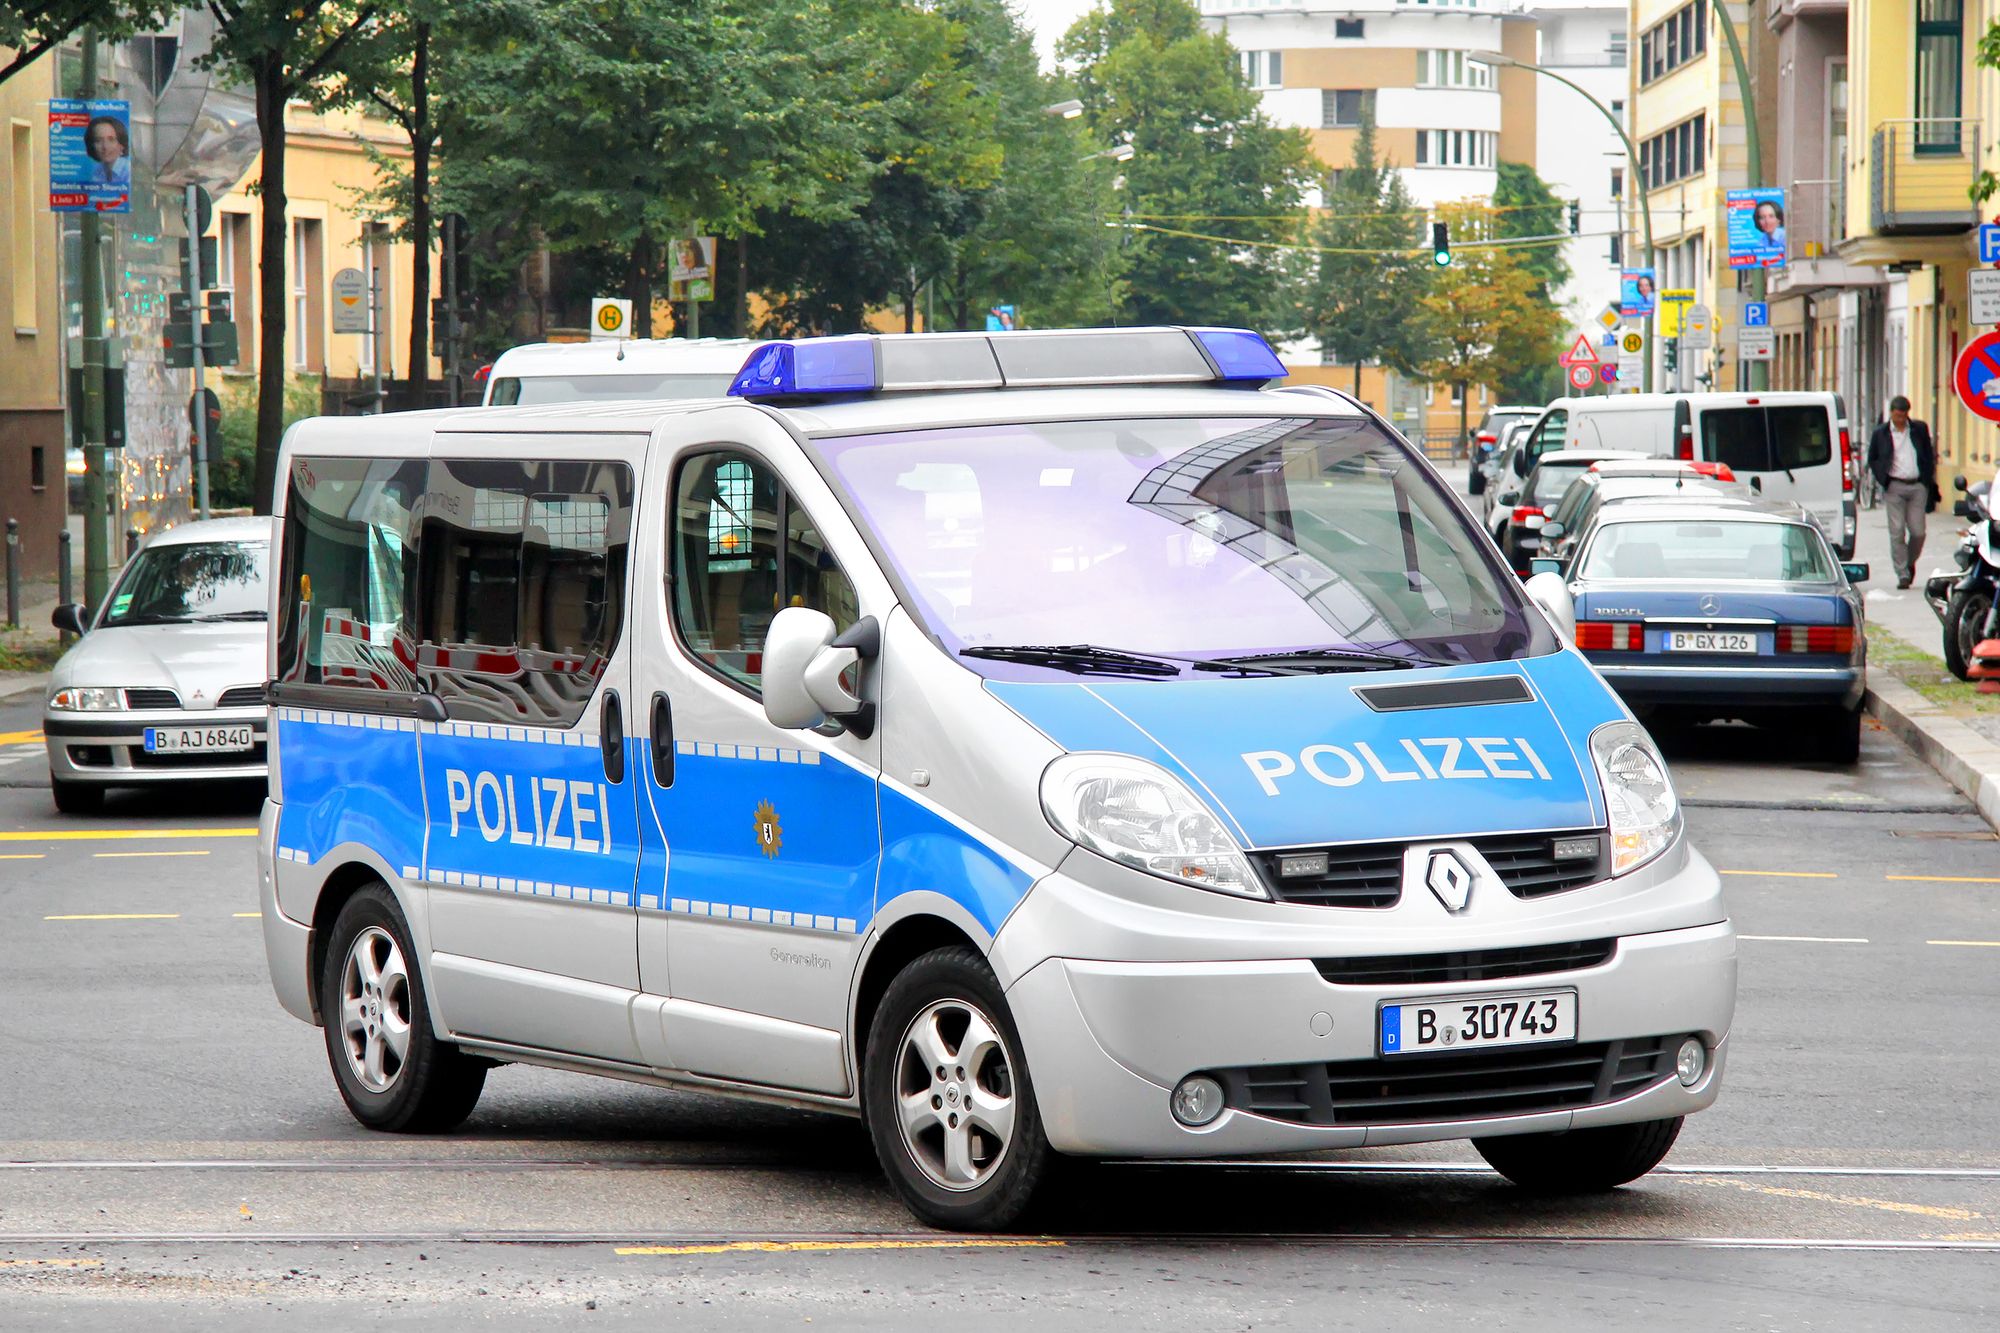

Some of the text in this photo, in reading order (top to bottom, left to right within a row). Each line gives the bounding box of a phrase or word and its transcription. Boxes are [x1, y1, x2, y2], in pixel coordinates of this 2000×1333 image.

[604, 310, 616, 325] H
[1748, 305, 1761, 324] P
[1627, 337, 1637, 349] H
[1574, 369, 1590, 381] 30
[1675, 634, 1748, 650] B GX 126
[156, 729, 249, 748] B AJ 6840
[1240, 737, 1553, 797] POLIZEI
[446, 768, 612, 855] POLIZEI
[770, 947, 831, 969] Generation
[1388, 999, 1558, 1044] D B 30743
